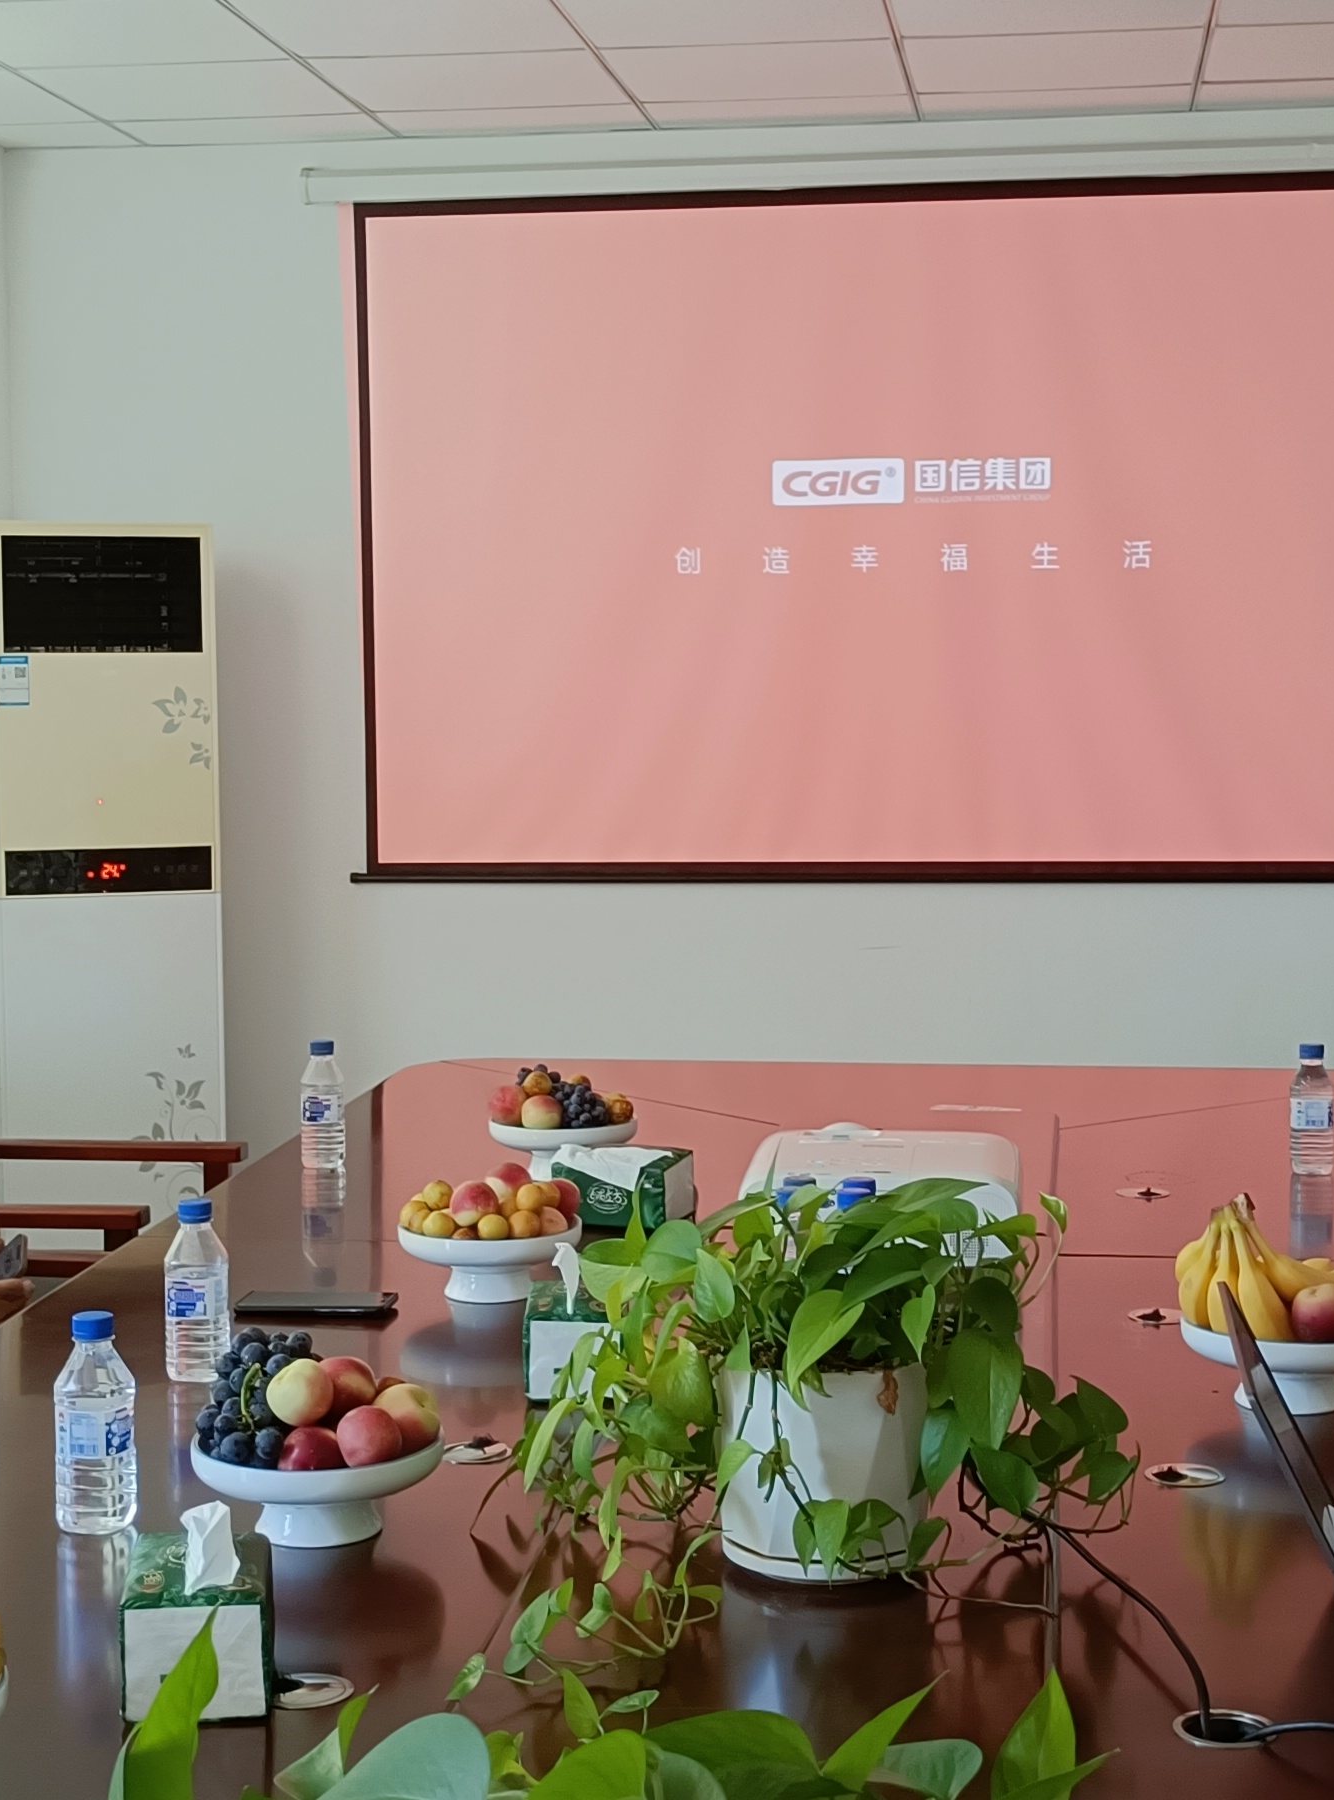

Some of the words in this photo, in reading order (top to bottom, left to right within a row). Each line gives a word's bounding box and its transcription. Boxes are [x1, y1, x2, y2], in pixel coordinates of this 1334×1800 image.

[781, 470, 881, 497] CGIG
[914, 457, 1051, 492] 国信集团
